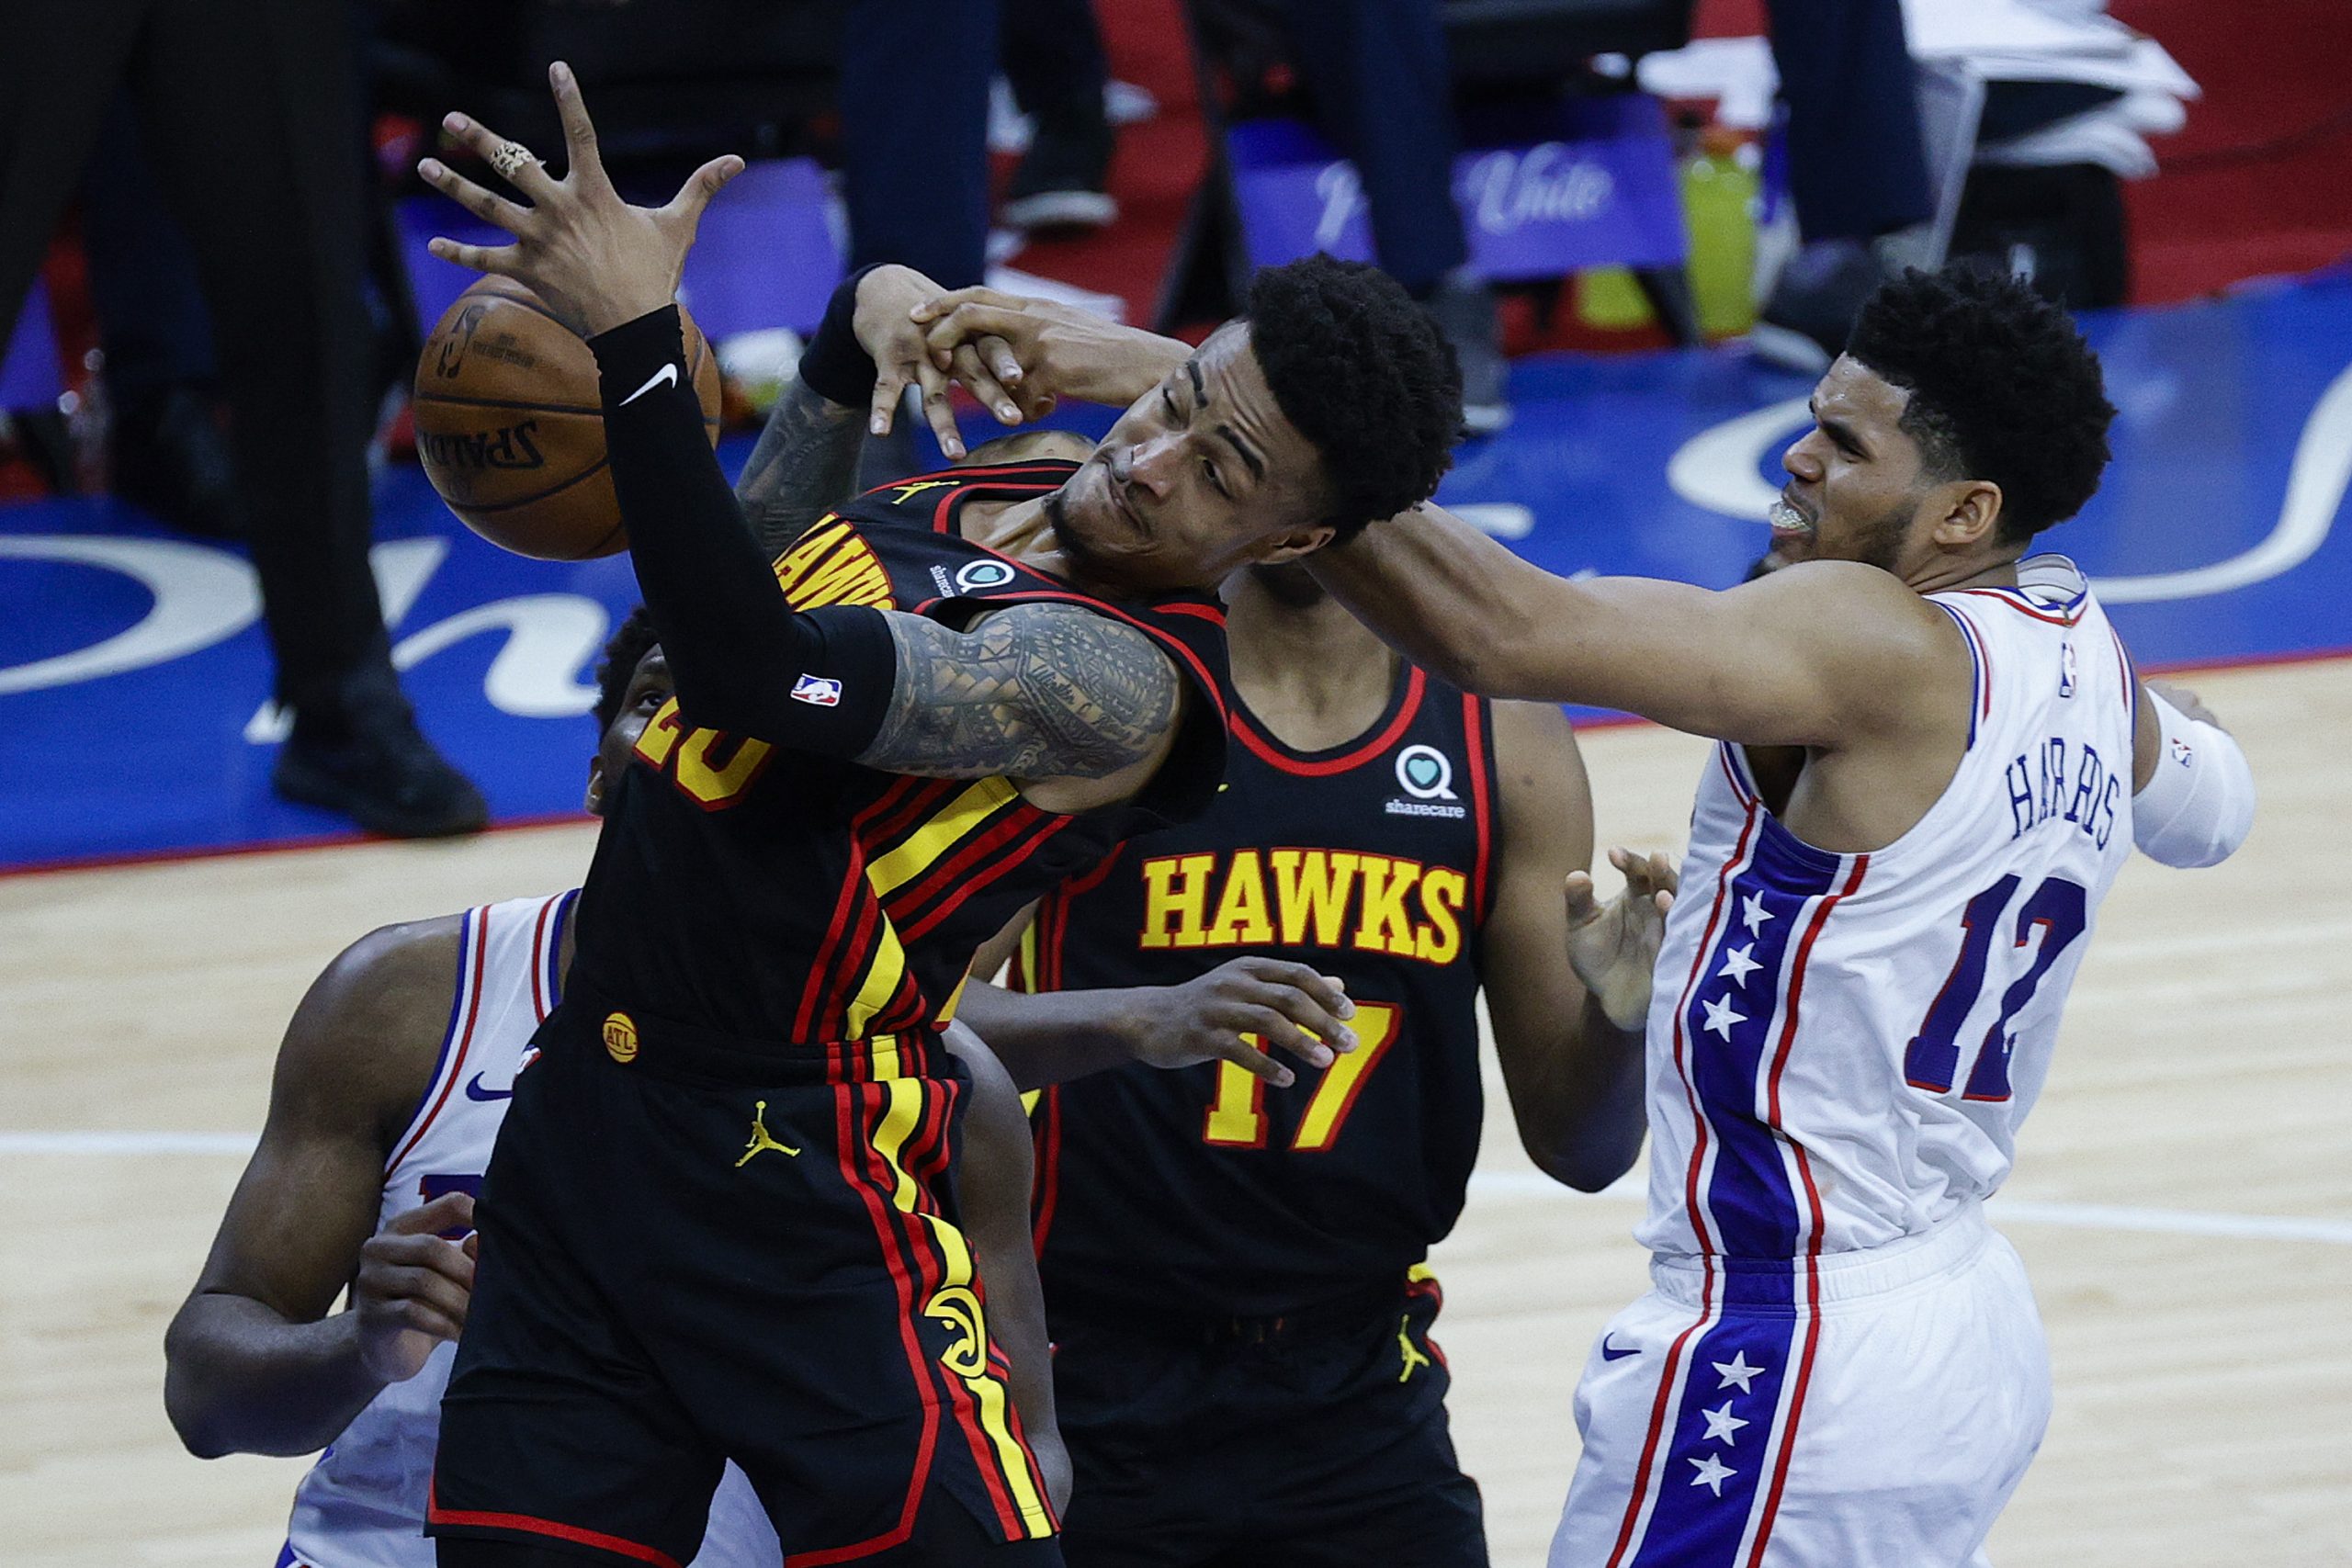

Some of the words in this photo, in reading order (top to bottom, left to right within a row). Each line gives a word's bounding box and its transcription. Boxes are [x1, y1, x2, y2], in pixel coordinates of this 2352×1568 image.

[1385, 798, 1466, 819] sharecare
[1139, 847, 1467, 965] HAWKS
[607, 1024, 634, 1051] ATL
[1904, 873, 2086, 1102] 12
[1203, 999, 1403, 1152] 17
